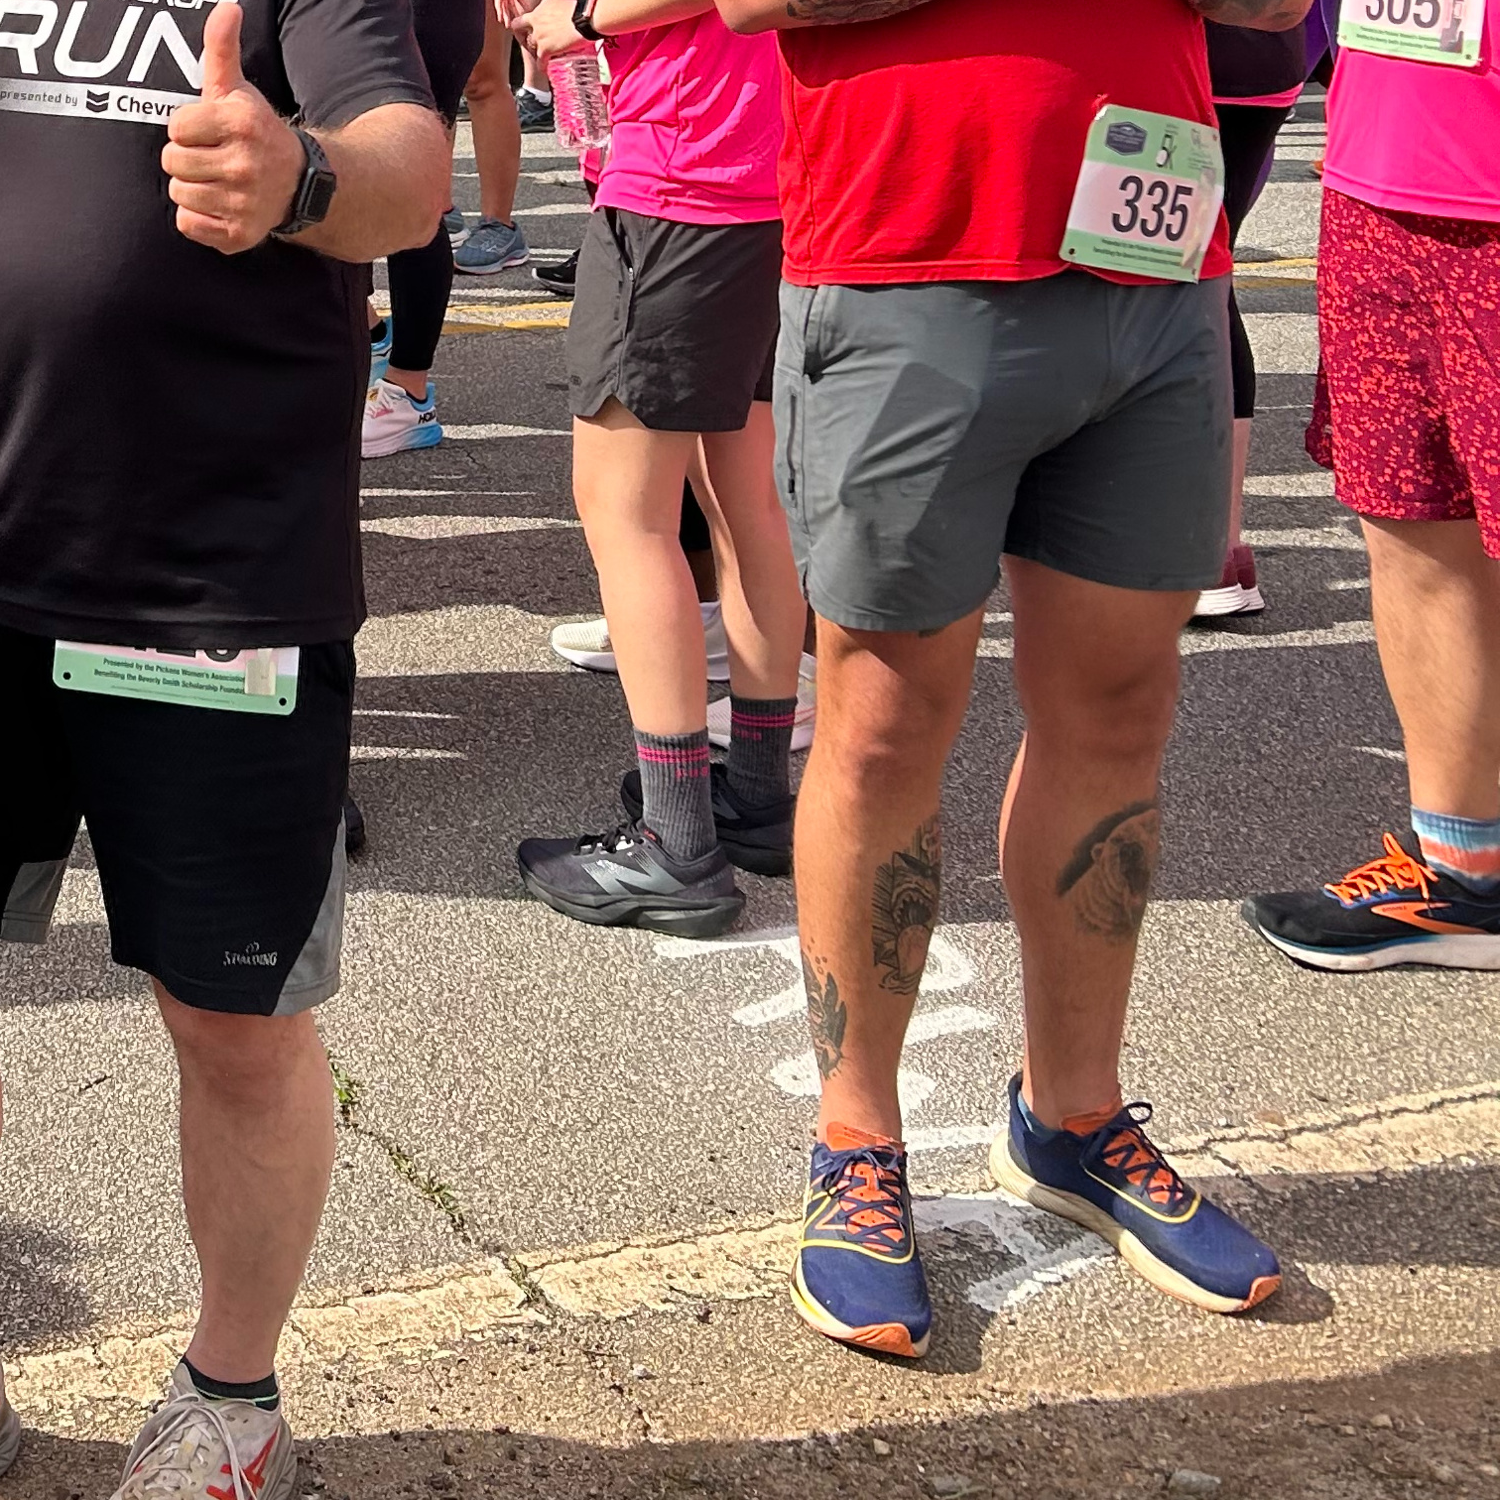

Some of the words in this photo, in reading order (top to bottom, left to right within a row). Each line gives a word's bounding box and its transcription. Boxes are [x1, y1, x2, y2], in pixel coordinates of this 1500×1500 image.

[0, 89, 62, 104] presented
[65, 93, 78, 106] by
[116, 94, 178, 117] Chevr
[1112, 175, 1193, 242] 335
